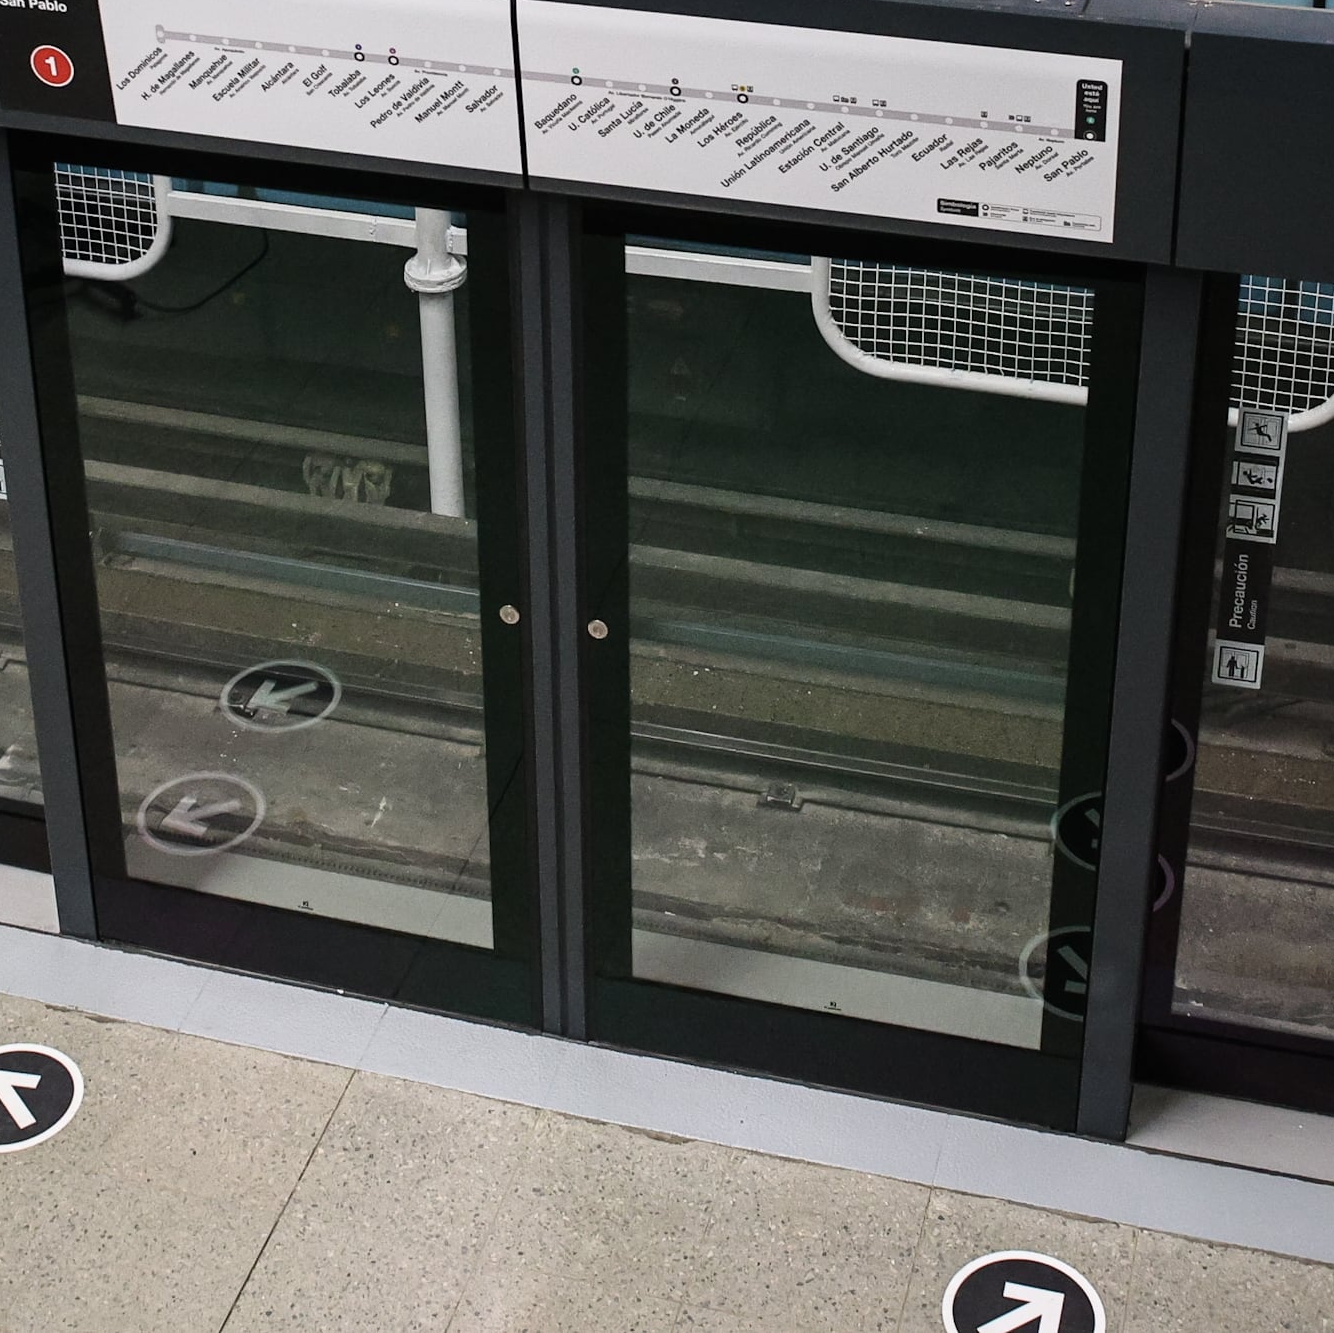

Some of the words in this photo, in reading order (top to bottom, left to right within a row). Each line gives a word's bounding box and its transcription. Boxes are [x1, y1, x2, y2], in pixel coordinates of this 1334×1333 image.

[44, 56, 58, 77] 1
[115, 77, 131, 91] Los
[127, 47, 163, 79] Dominicos
[140, 92, 152, 101] H.
[150, 83, 161, 94] de
[157, 50, 195, 85] Magallanes
[188, 54, 227, 90] Manquehue
[212, 77, 240, 102] Escuela
[236, 57, 260, 79] Militar
[260, 61, 295, 93] Alcántara
[302, 77, 313, 88] El
[310, 63, 328, 80] Golf
[327, 68, 362, 98] Tobalaba
[354, 95, 369, 109] Los
[367, 72, 397, 98] Leones
[370, 108, 393, 129] Pedro
[392, 99, 404, 111] de
[401, 76, 430, 101] Valdivia
[414, 99, 443, 124] Manuel
[440, 80, 465, 101] Montt
[465, 84, 499, 114] Salvador
[534, 92, 578, 130] Baquedano
[568, 122, 580, 132] U.
[577, 96, 611, 123] Católica
[597, 119, 623, 138] Santa
[623, 100, 644, 120] Lucía
[633, 129, 645, 139] U.
[643, 120, 655, 131] de
[653, 104, 676, 123] Chile
[665, 132, 678, 144] La
[675, 107, 710, 135] Moneda
[697, 134, 715, 148] Los
[712, 111, 743, 136] Héroes
[735, 115, 777, 148] República
[778, 145, 815, 174] Estación
[813, 121, 845, 147] Central
[911, 133, 948, 162] Ecuador
[720, 168, 747, 188] Unión
[743, 118, 811, 170] Latinoamericana
[819, 163, 831, 172] U.
[830, 153, 843, 164] de
[840, 126, 879, 156] Santiago
[830, 178, 850, 193] San
[848, 156, 880, 180] Alberto
[877, 130, 914, 158] Hurtado
[940, 154, 959, 170] Las
[956, 137, 984, 158] Rejas
[979, 141, 1018, 171] Pajaritos
[1014, 145, 1053, 174] Neptuno
[1043, 167, 1063, 183] San
[1061, 149, 1089, 170] Pablo
[1229, 553, 1249, 628] Precaución
[1247, 599, 1258, 630] Caution
